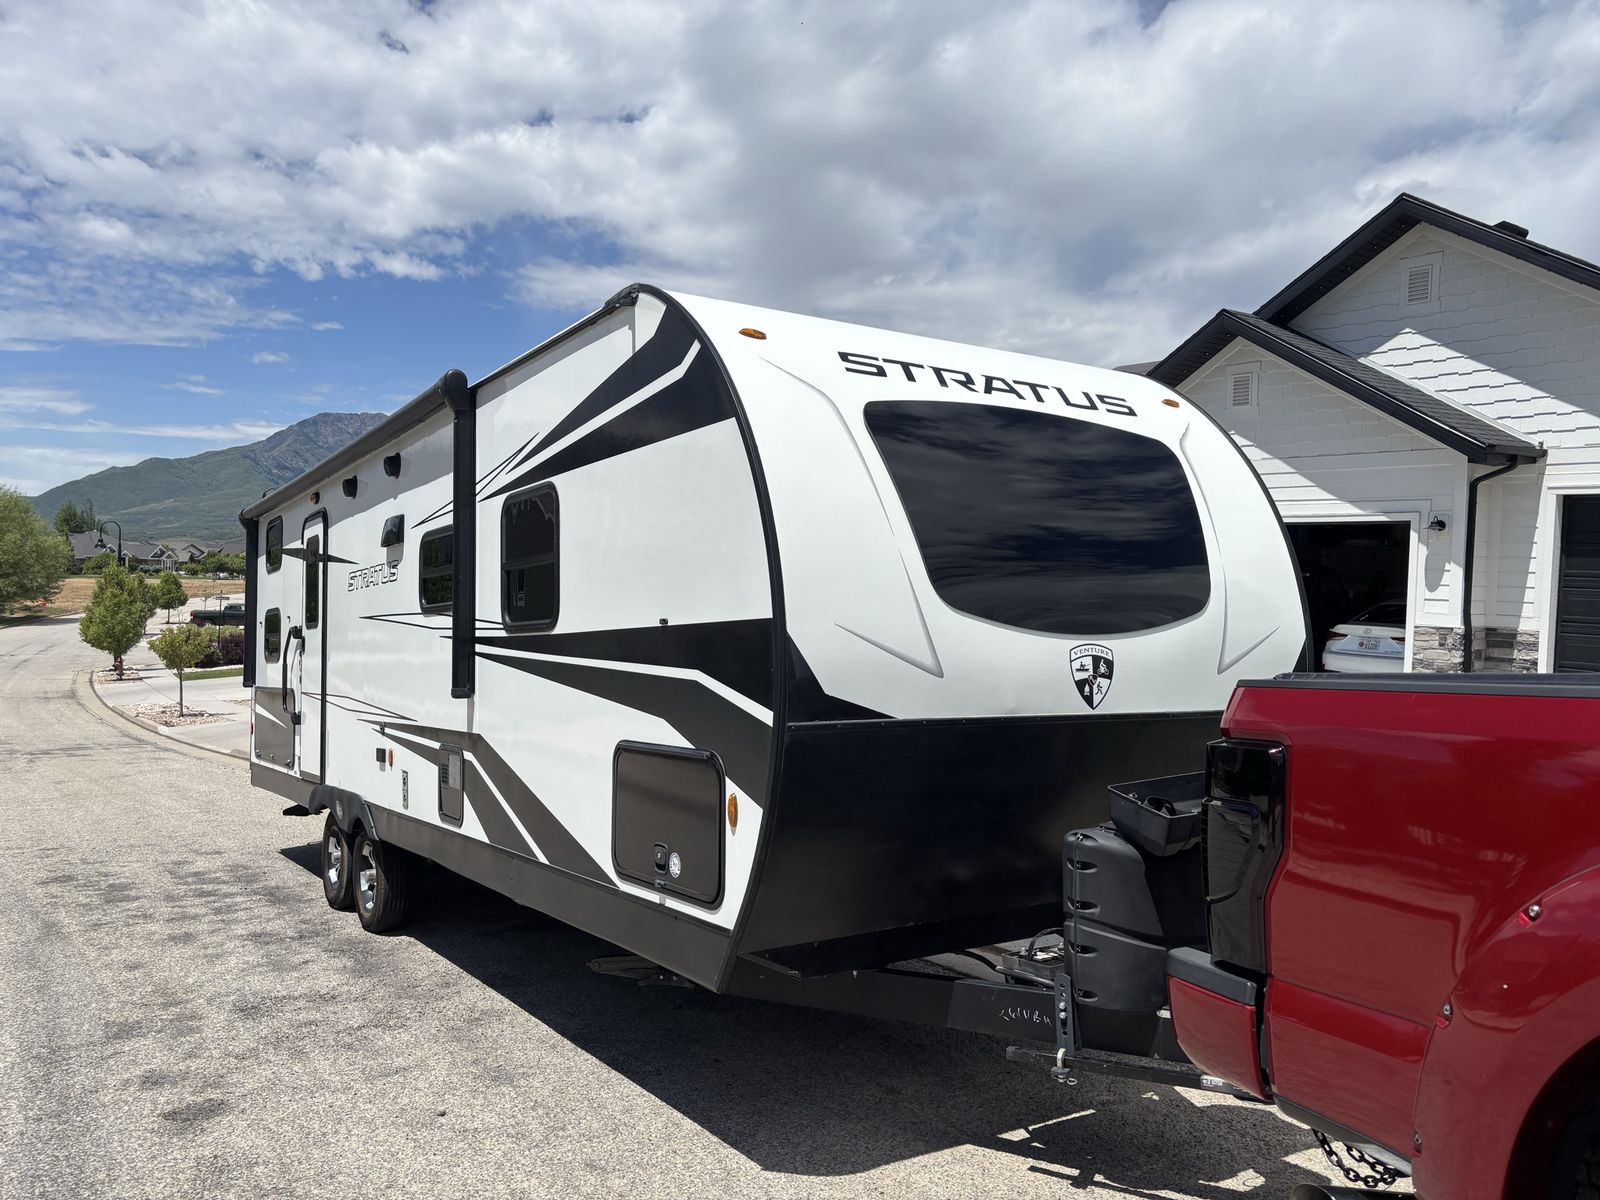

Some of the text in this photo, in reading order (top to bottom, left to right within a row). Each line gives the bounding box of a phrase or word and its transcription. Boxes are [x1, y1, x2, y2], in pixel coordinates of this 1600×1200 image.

[837, 351, 1138, 417] STRATUS
[347, 559, 400, 592] STRATUS
[1073, 647, 1110, 656] VENTURE
